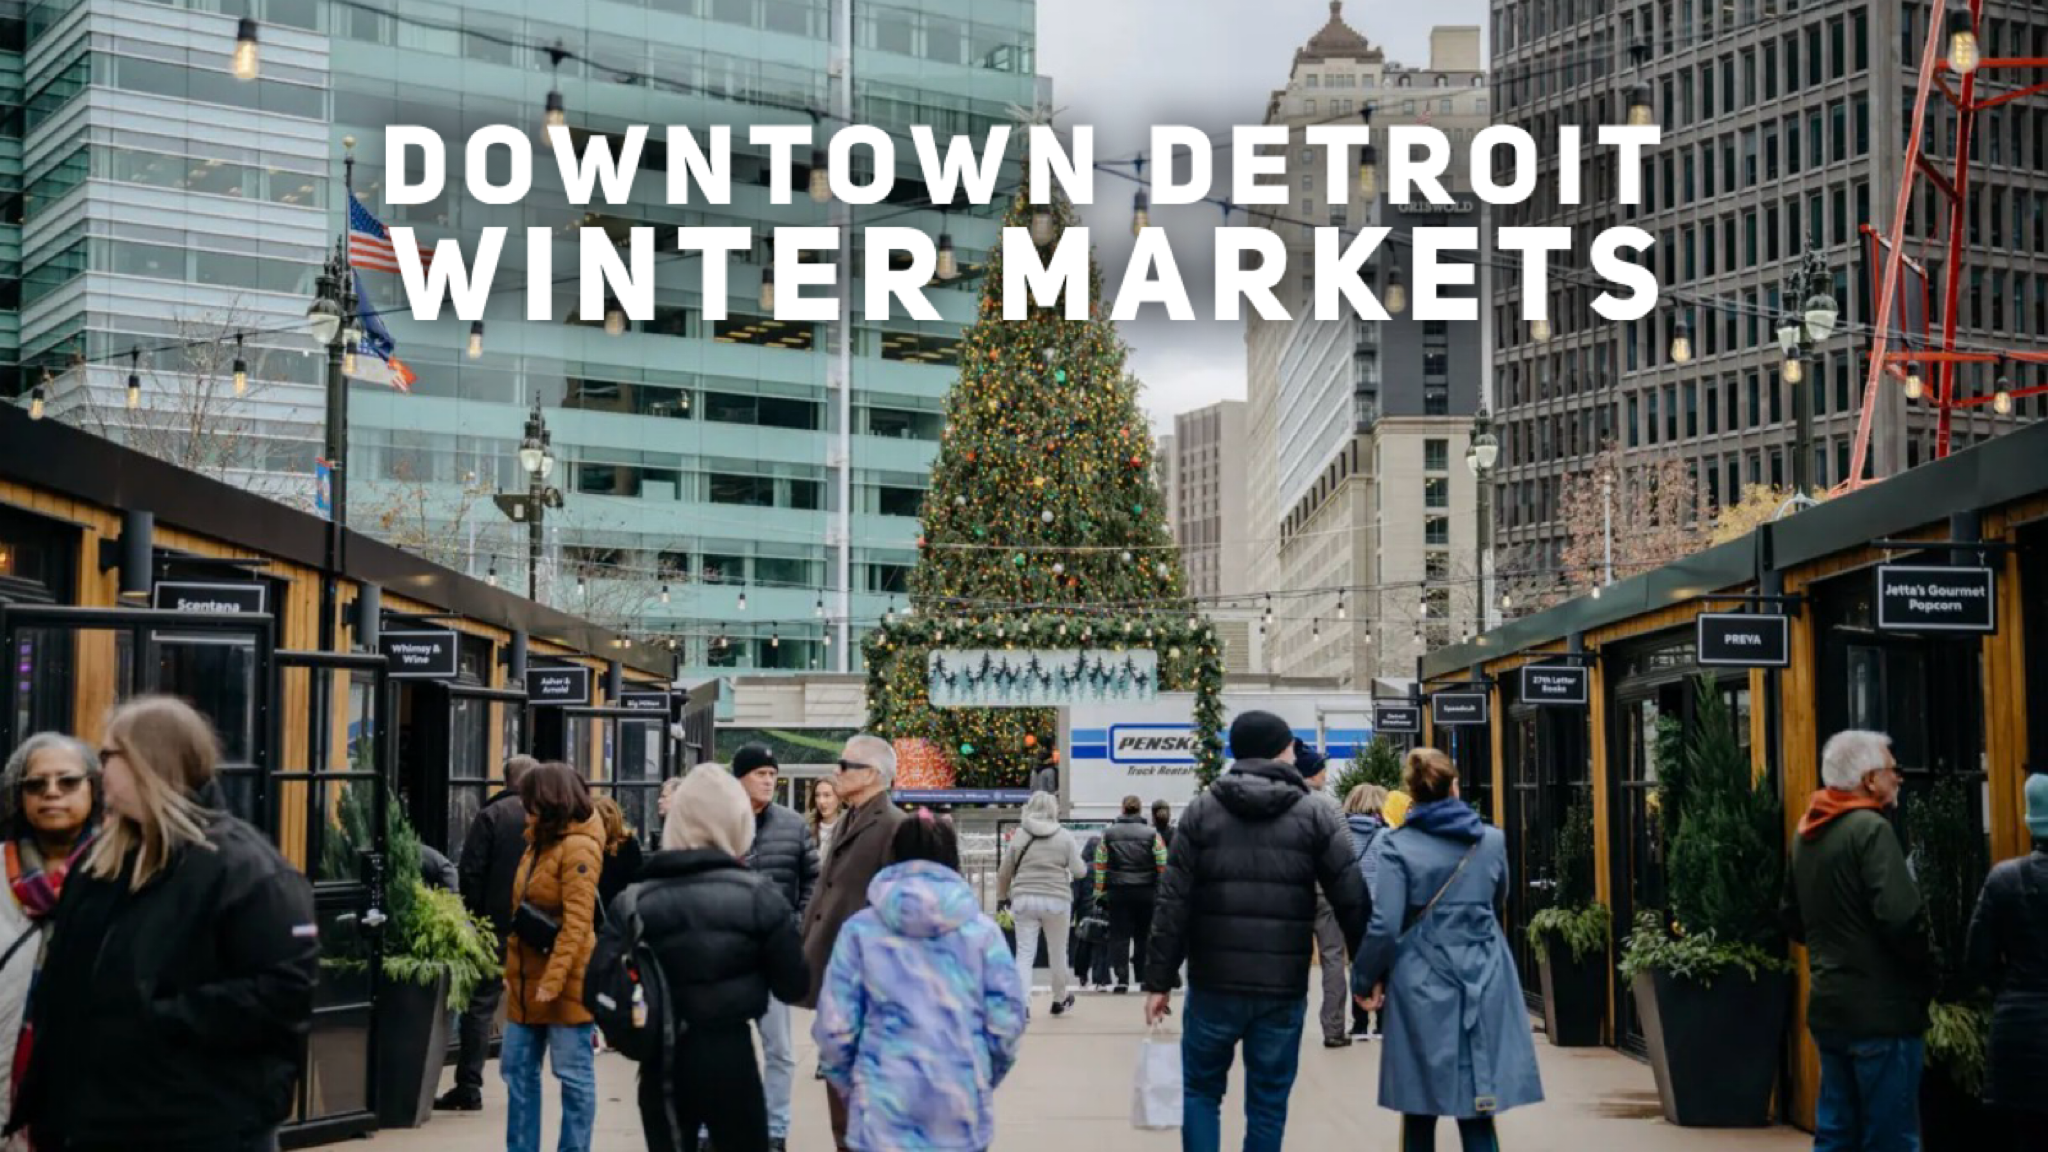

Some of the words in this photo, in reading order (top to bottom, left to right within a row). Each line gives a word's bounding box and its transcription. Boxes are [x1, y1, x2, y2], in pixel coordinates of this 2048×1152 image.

[1885, 584, 1926, 596] Jetta's
[1928, 584, 1985, 597] Gourmet
[177, 598, 240, 613] Scentana
[1908, 598, 1962, 613] Popcorn
[432, 643, 442, 654] &
[402, 654, 430, 664] Wine
[1127, 765, 1156, 775] Truck
